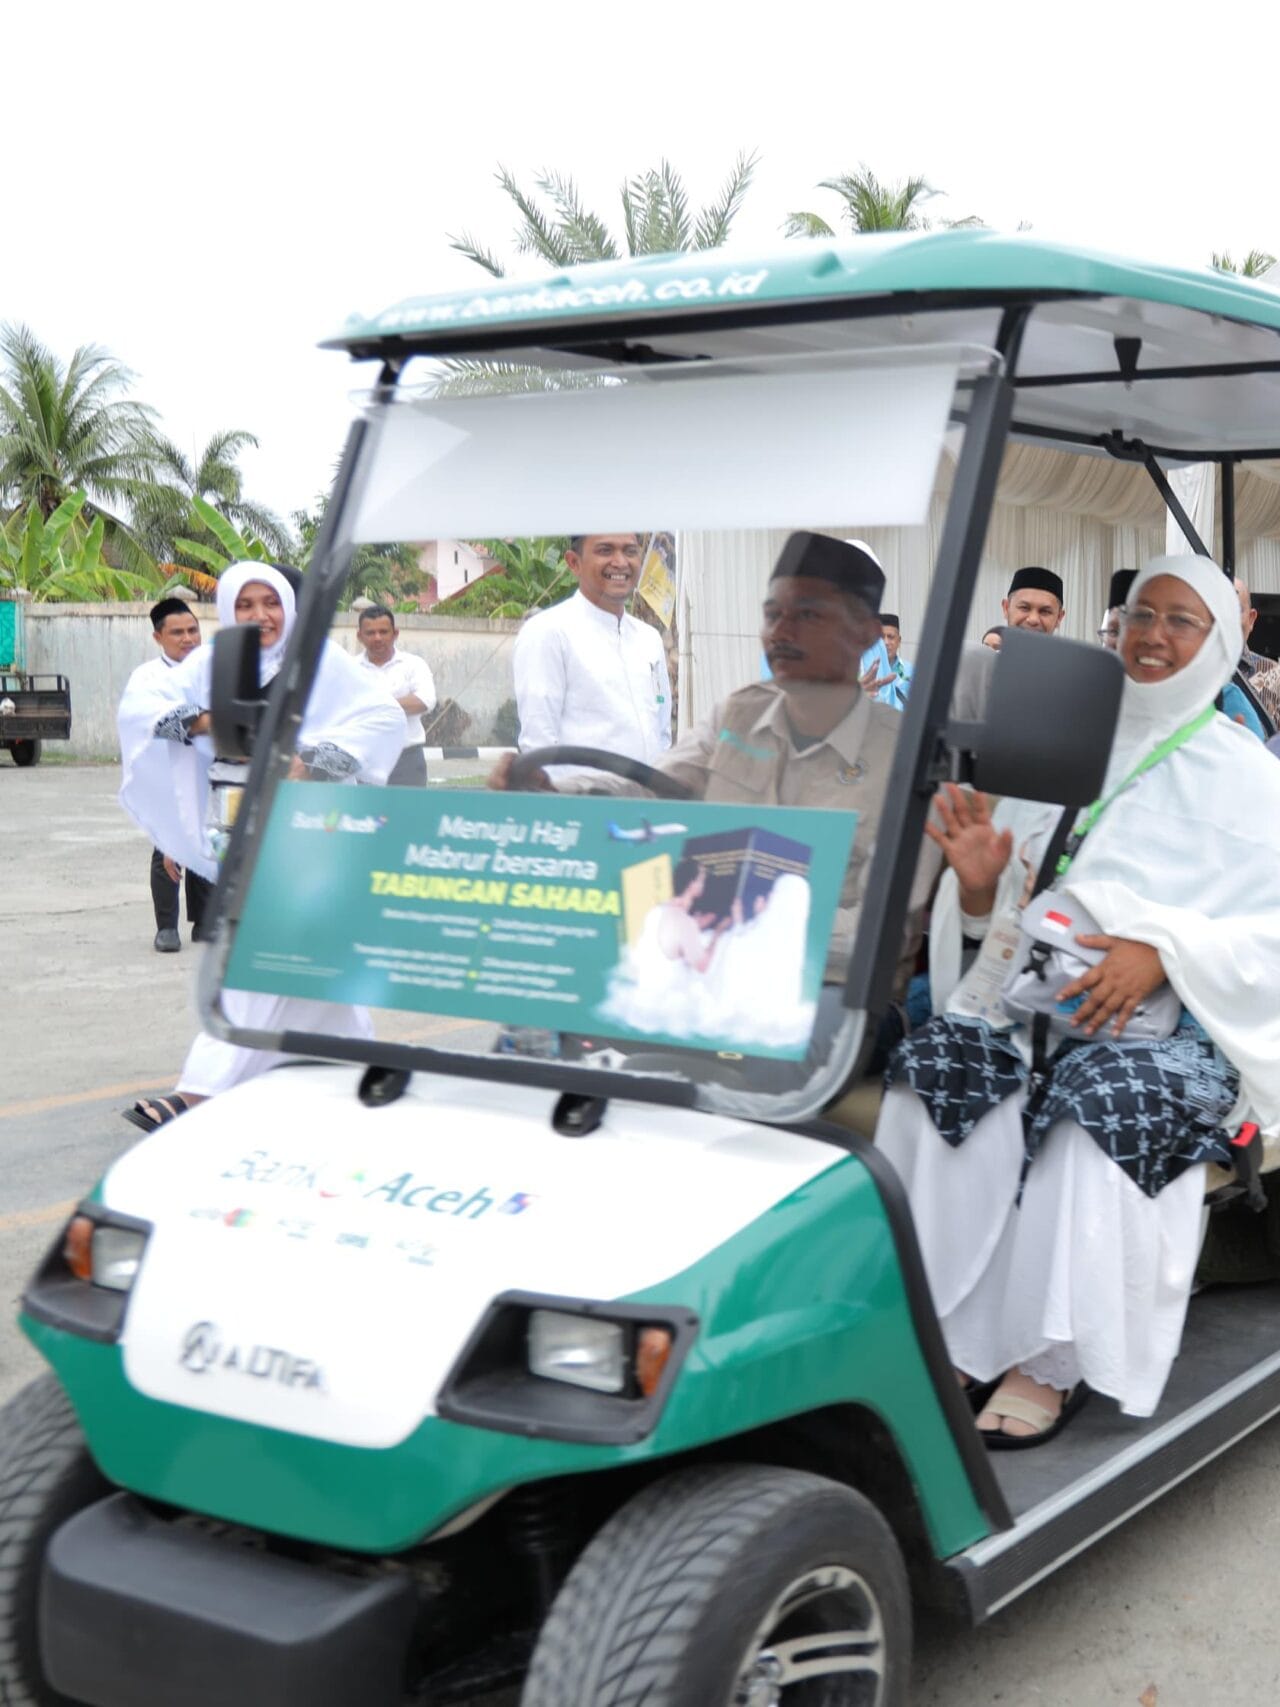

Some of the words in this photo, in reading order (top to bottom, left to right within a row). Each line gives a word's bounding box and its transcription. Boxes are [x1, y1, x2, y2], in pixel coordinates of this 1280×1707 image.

[437, 814, 527, 848] Menuju
[530, 820, 582, 852] Haji
[404, 843, 490, 872] Mabrur
[491, 848, 598, 881] bersama
[370, 870, 509, 905] TABUNGAN
[509, 881, 621, 916] SAHARA
[362, 1172, 494, 1220] Aceh
